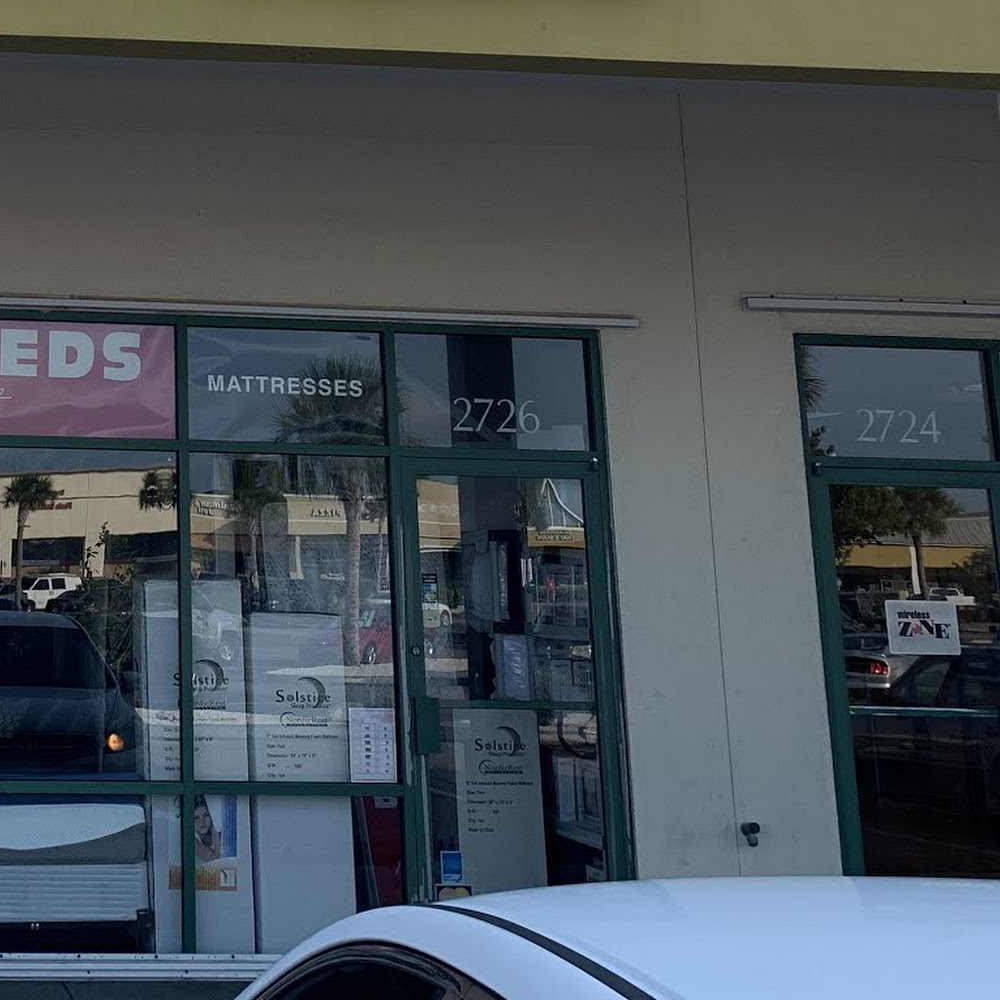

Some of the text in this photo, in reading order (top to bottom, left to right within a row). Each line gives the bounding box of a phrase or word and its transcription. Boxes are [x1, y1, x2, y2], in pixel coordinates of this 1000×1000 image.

[207, 374, 363, 398] MATTRESSES
[453, 397, 540, 434] 2726
[857, 408, 942, 443] 2724
[897, 610, 930, 619] wireless
[897, 619, 951, 639] ZONE
